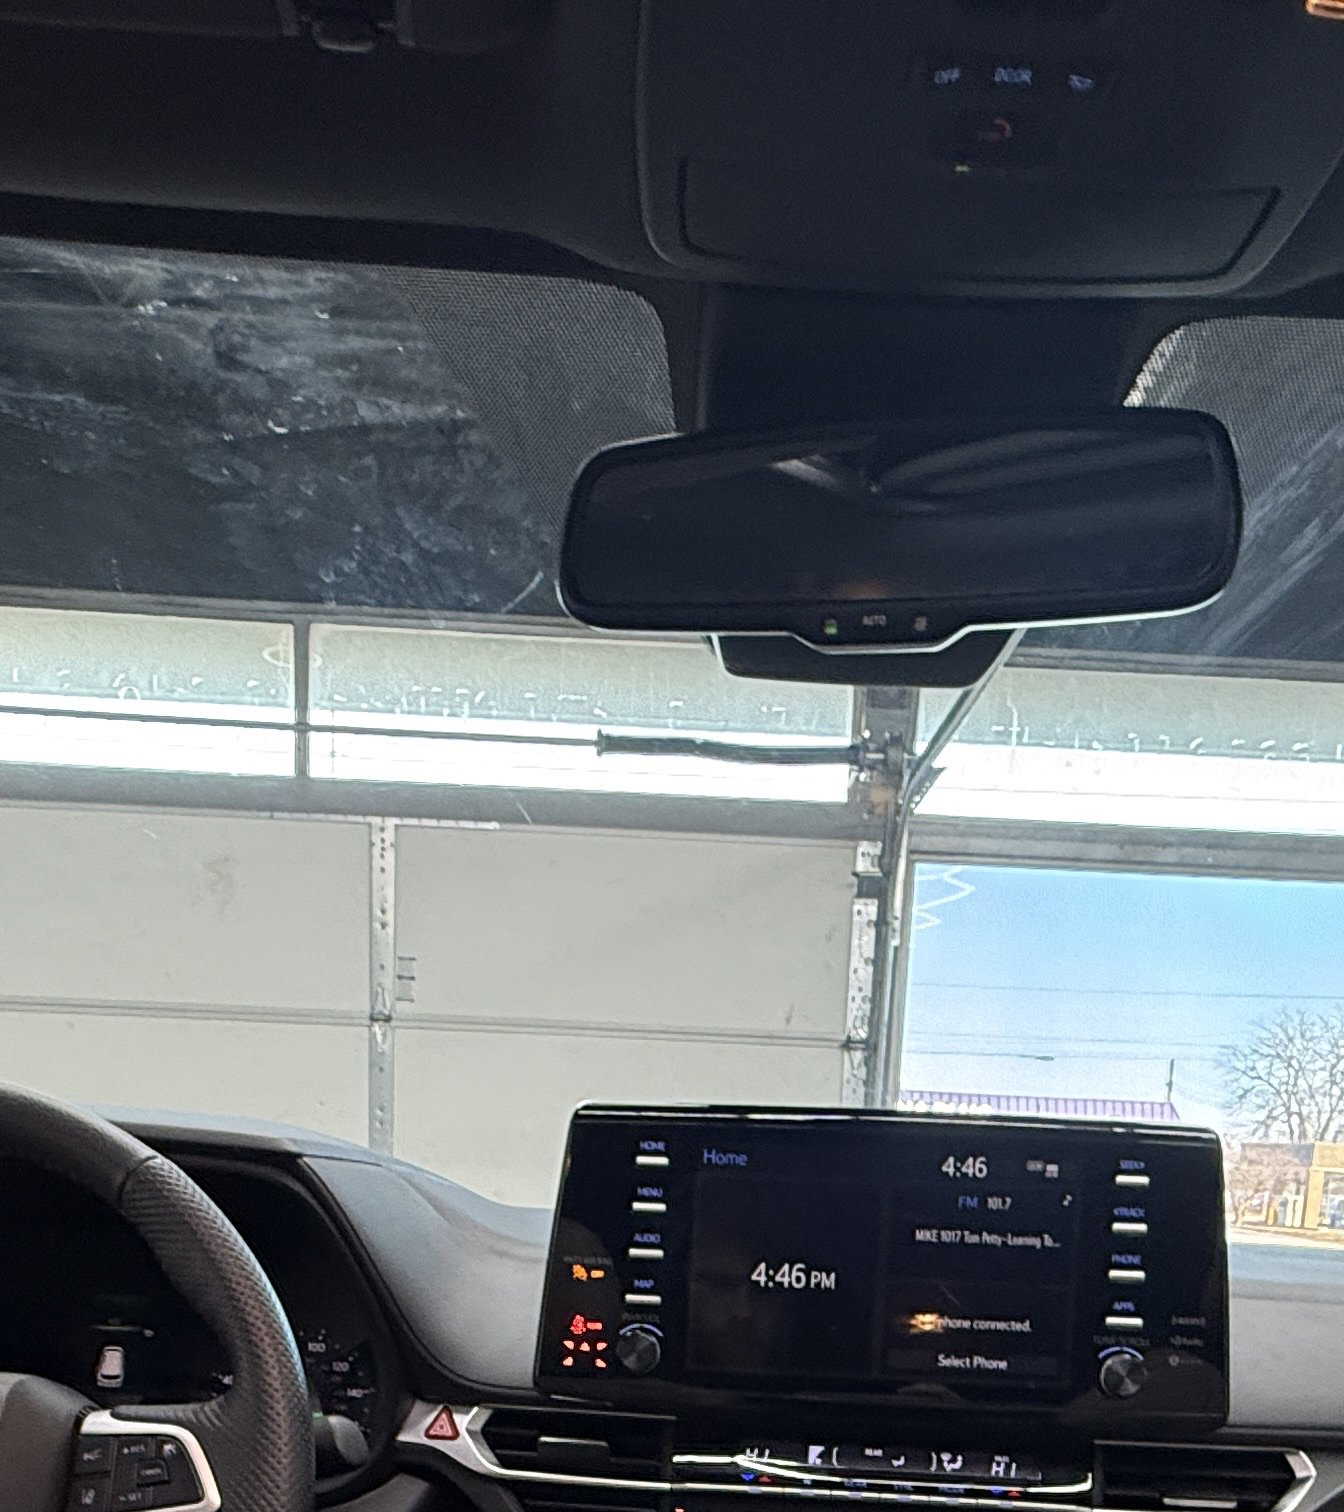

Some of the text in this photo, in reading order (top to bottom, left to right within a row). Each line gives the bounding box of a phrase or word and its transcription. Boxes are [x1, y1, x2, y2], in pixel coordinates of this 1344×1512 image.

[639, 1140, 666, 1152] HOME
[702, 1147, 749, 1167] Home
[940, 1155, 989, 1179] 4:46
[637, 1186, 663, 1198] MENU
[958, 1196, 1012, 1210] FM 101.7
[633, 1232, 661, 1244] AUDIO
[915, 1228, 939, 1243] MIKE
[751, 1261, 836, 1291] 4:46 PM
[972, 1317, 1033, 1333] connected.
[936, 1353, 1008, 1371] Select Phone
